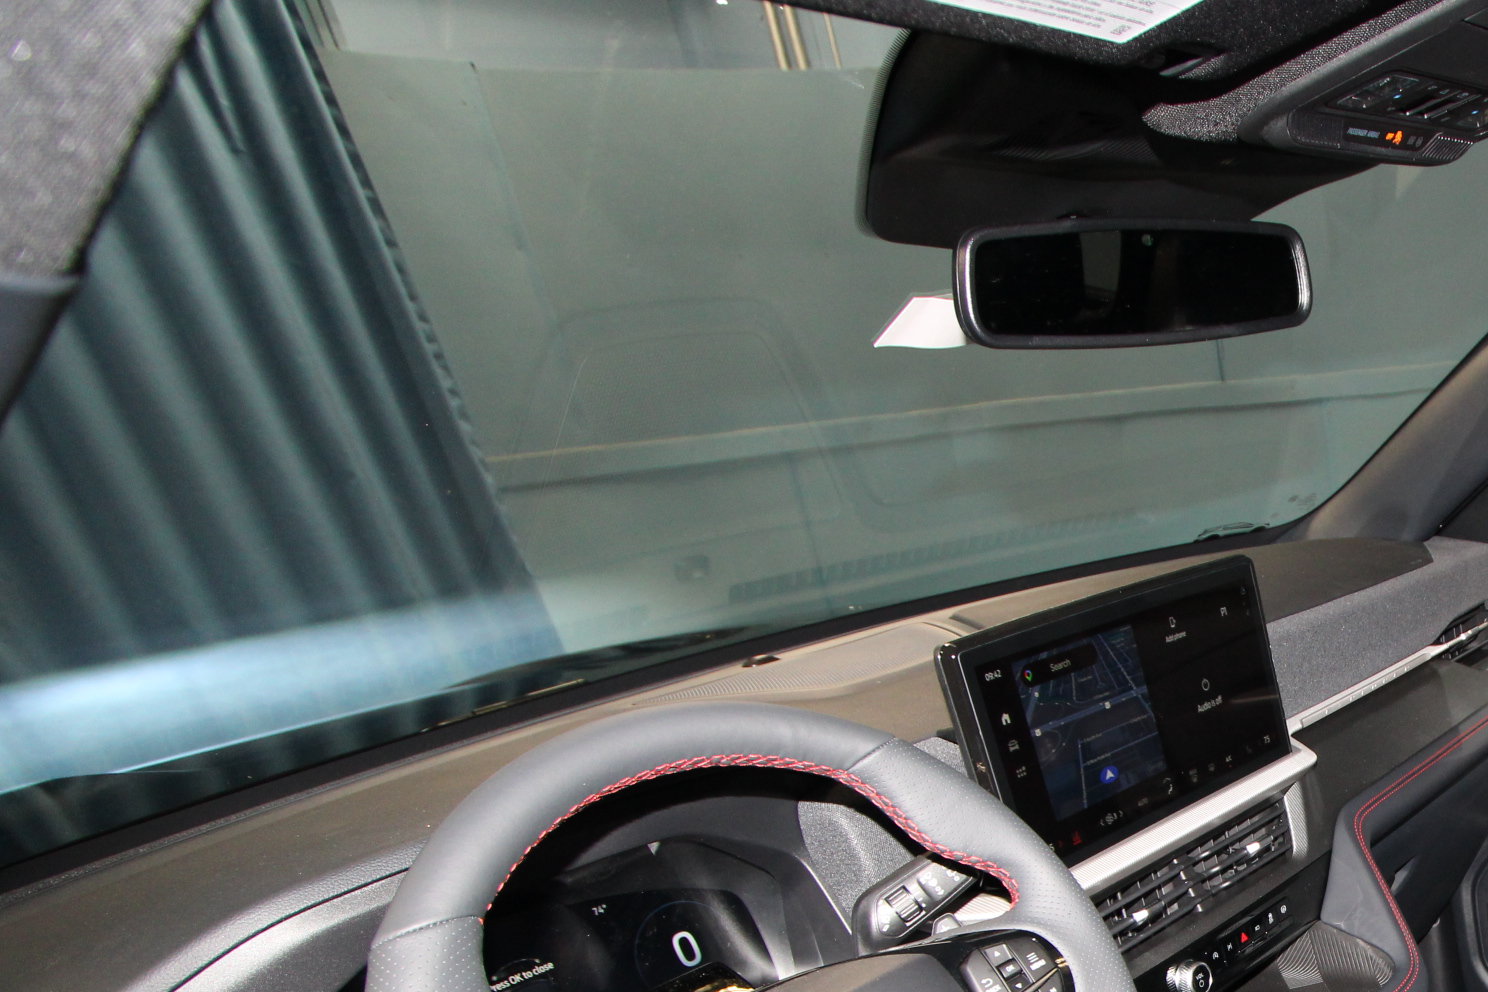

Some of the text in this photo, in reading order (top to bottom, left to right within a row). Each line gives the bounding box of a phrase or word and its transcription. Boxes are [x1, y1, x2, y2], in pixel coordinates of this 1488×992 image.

[1049, 658, 1072, 672] Search
[985, 669, 1002, 681] 09:42
[672, 931, 702, 967] 0
[508, 972, 524, 985] OK
[522, 970, 533, 980] to
[532, 962, 555, 976] close
